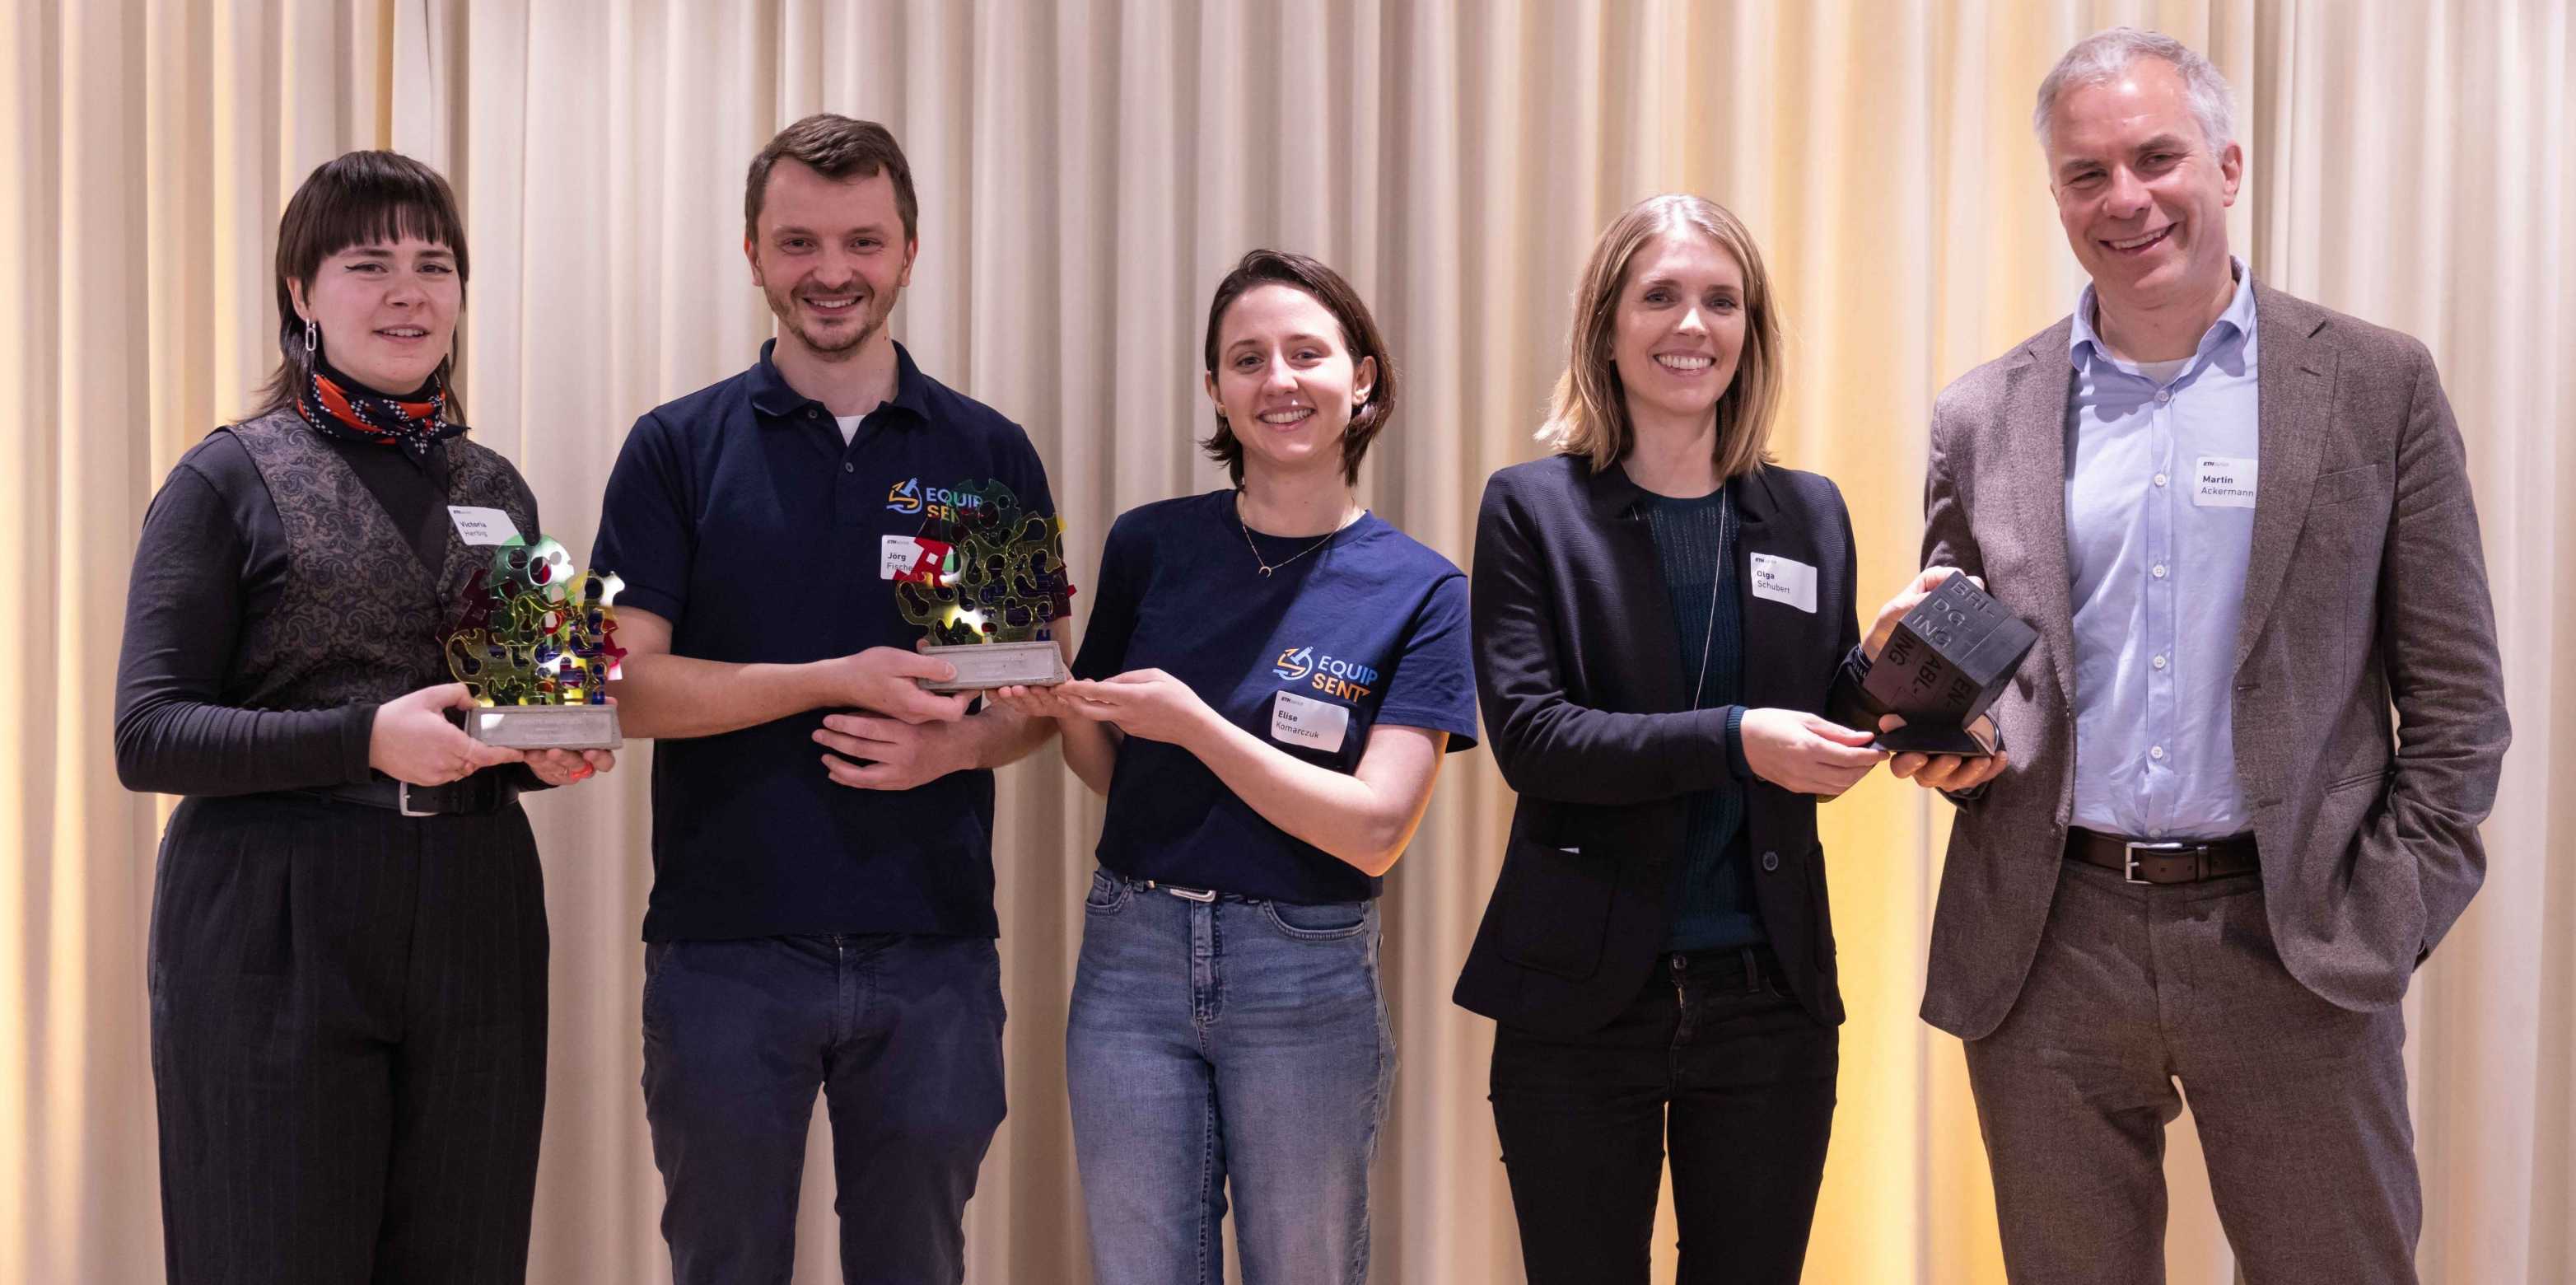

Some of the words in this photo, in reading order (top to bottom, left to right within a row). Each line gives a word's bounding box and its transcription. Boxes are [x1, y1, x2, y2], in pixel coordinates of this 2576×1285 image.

[2202, 475, 2233, 484] Martin
[926, 488, 982, 508] EQUIP
[2200, 487, 2254, 497] Ackermann
[887, 552, 907, 562] Jörg
[1756, 570, 1776, 580] Olga
[1757, 580, 1790, 595] Schubert
[1912, 614, 1952, 649] ING
[1888, 632, 1917, 666] ING
[1318, 656, 1378, 686] EQUIP
[1312, 673, 1370, 703] SENT
[1277, 710, 1298, 722] Elise
[1276, 722, 1319, 739] Komarczuk
